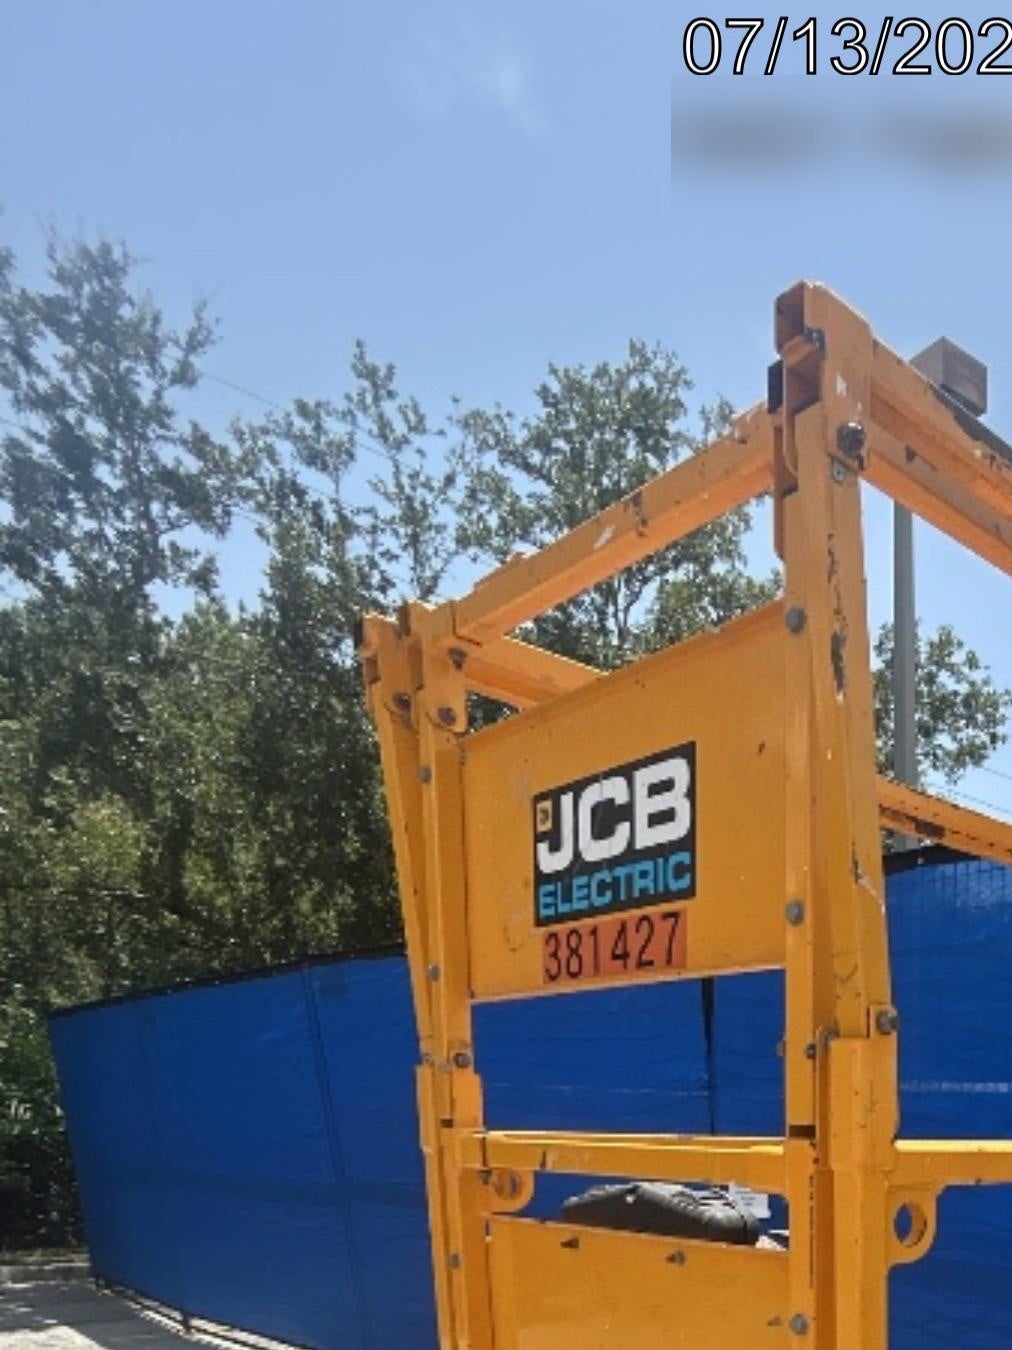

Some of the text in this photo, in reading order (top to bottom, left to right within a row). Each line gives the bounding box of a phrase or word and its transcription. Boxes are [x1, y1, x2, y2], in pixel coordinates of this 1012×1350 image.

[536, 756, 691, 874] JCB
[539, 851, 691, 919] ELECTRIC
[545, 911, 680, 981] 381427
